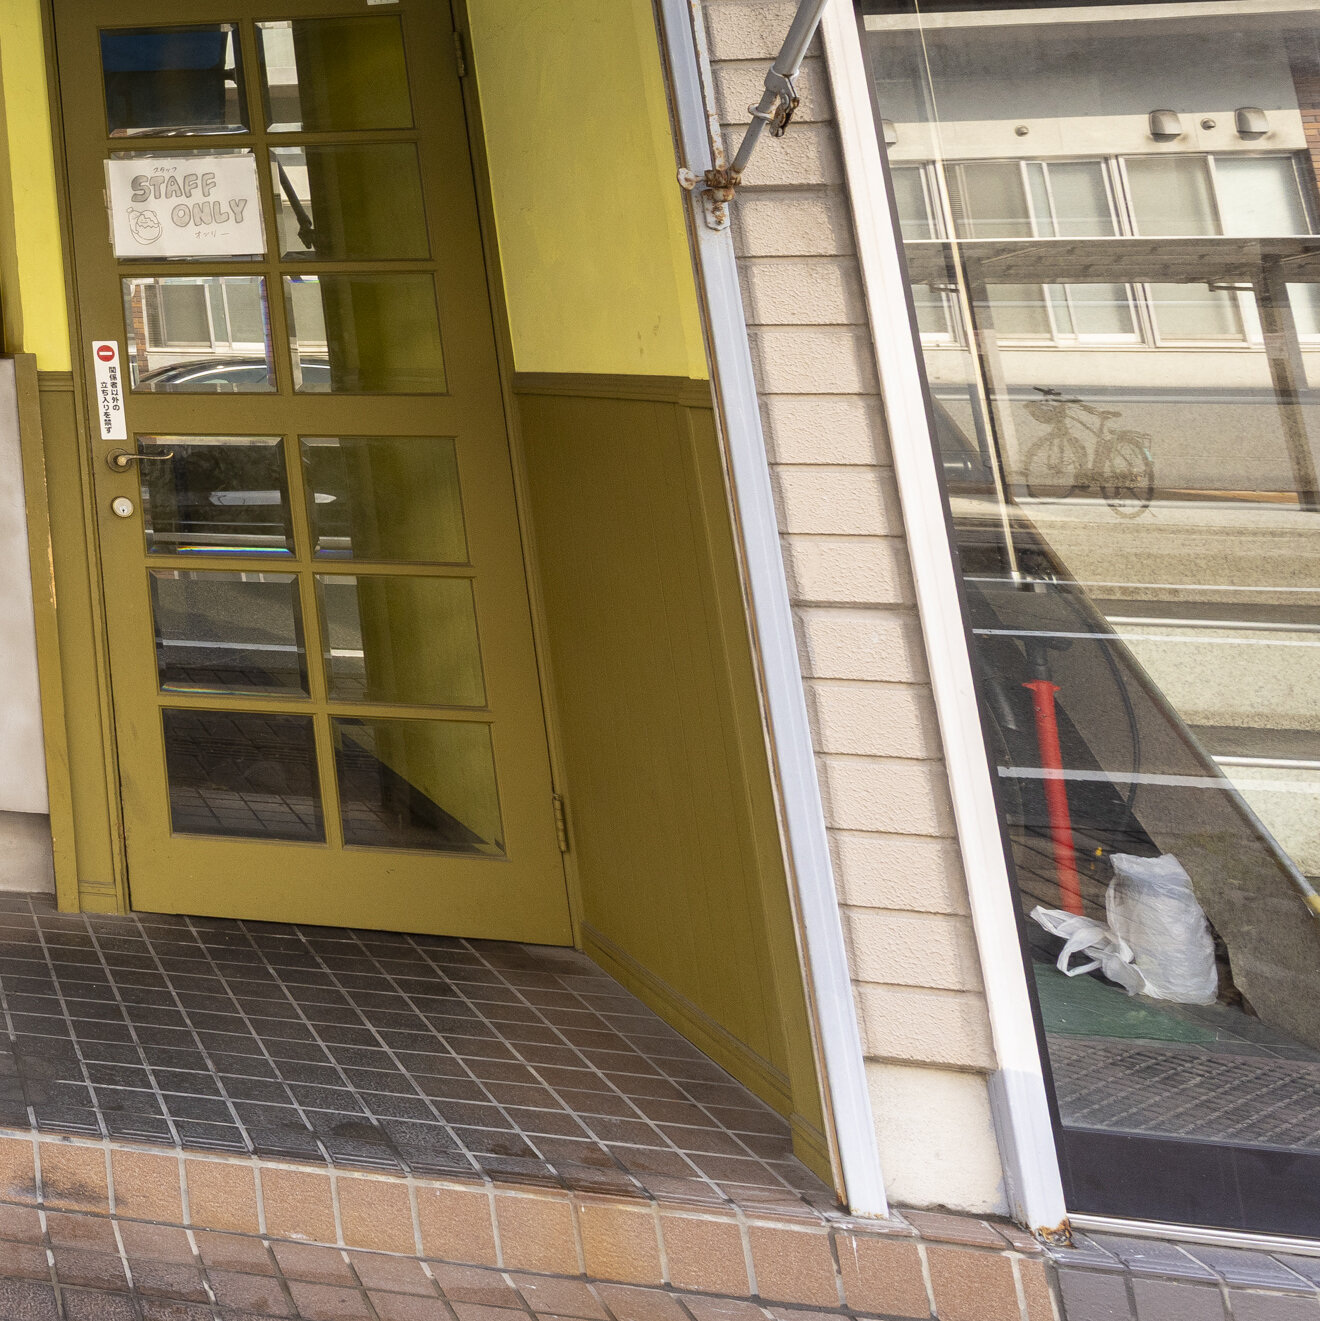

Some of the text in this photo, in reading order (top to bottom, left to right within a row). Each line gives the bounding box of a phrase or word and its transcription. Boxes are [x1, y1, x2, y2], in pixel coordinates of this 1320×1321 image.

[130, 172, 217, 203] STAFF
[171, 198, 248, 228] ONLY
[100, 381, 113, 434] 立ち入りを禁ず
[108, 366, 121, 411] 関係者以外の
